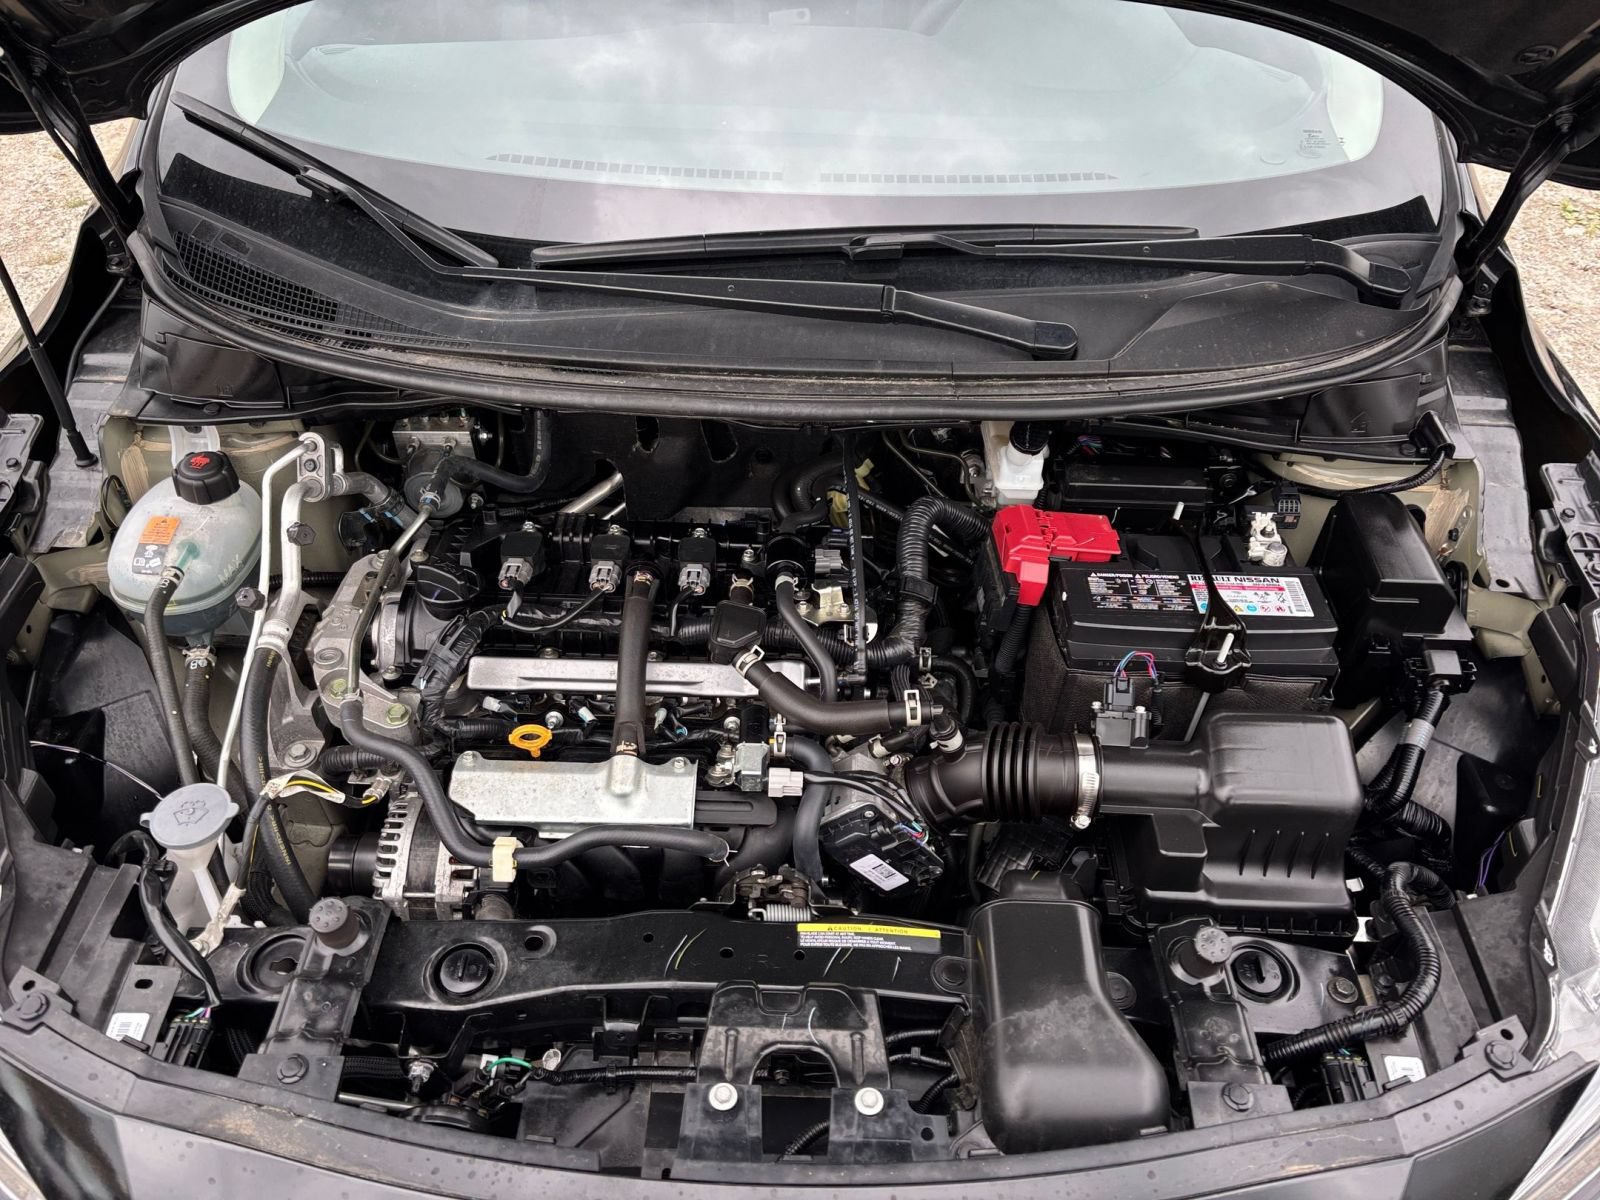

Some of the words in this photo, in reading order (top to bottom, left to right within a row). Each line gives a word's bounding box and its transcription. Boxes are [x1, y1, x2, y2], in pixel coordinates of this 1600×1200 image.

[217, 553, 244, 585] MAX
[1191, 575, 1231, 583] REULT
[1234, 576, 1280, 584] NISSAN
